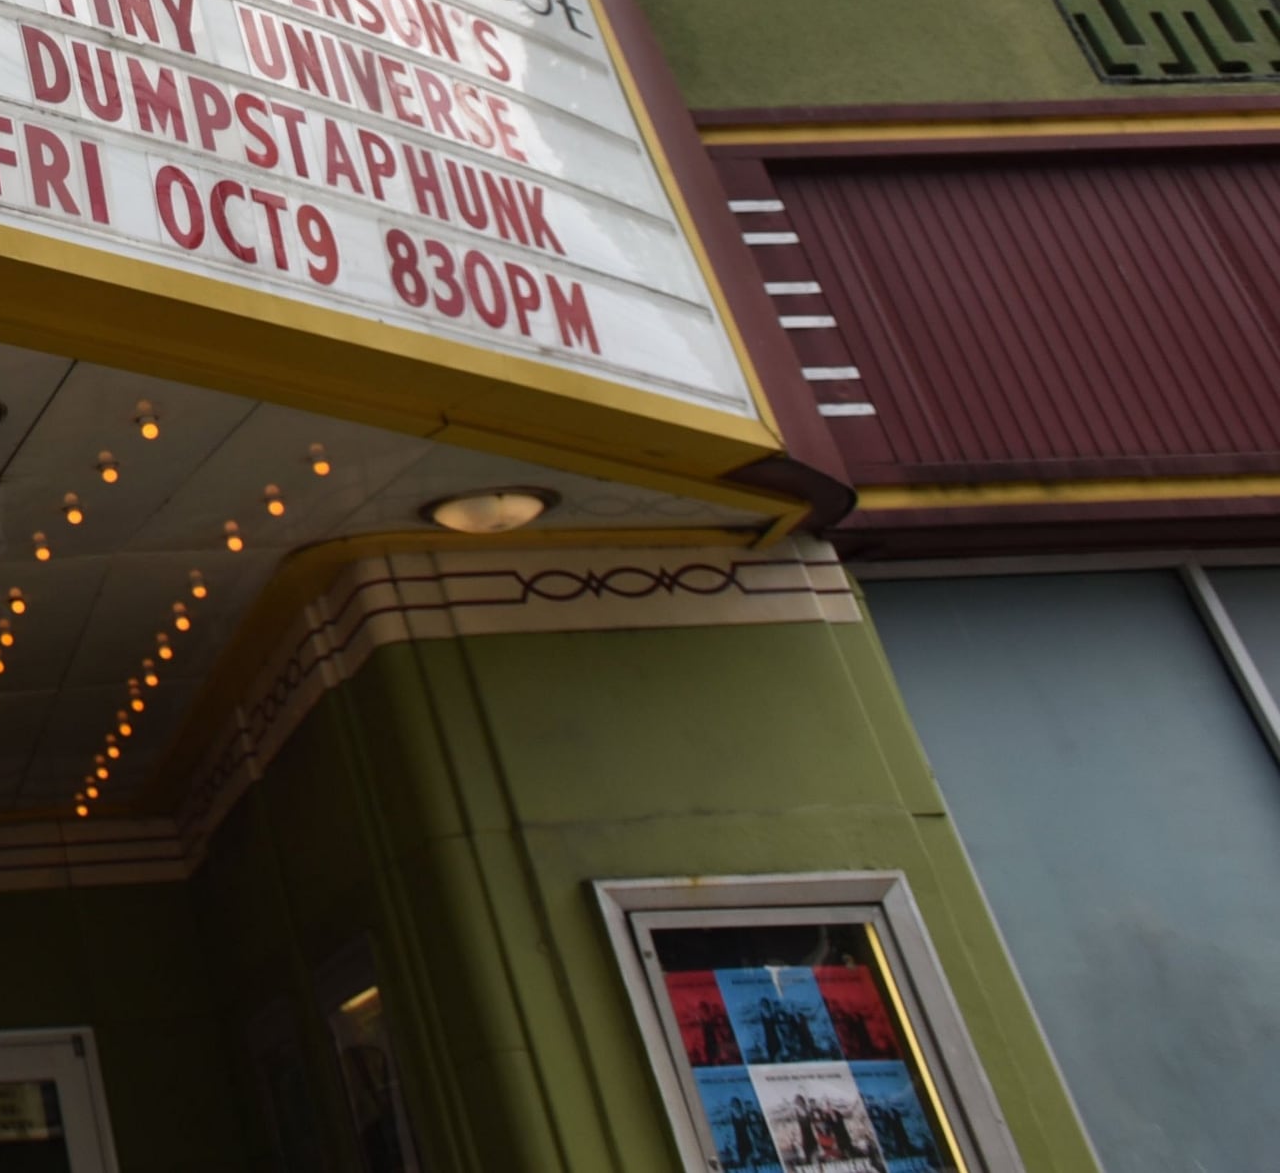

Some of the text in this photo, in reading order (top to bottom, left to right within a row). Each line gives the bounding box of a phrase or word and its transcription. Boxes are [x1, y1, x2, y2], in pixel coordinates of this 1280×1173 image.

[22, 25, 565, 256] DUMPSTAPHUNK
[241, 10, 526, 162] UNIVERSE
[385, 229, 601, 354] 830PM
